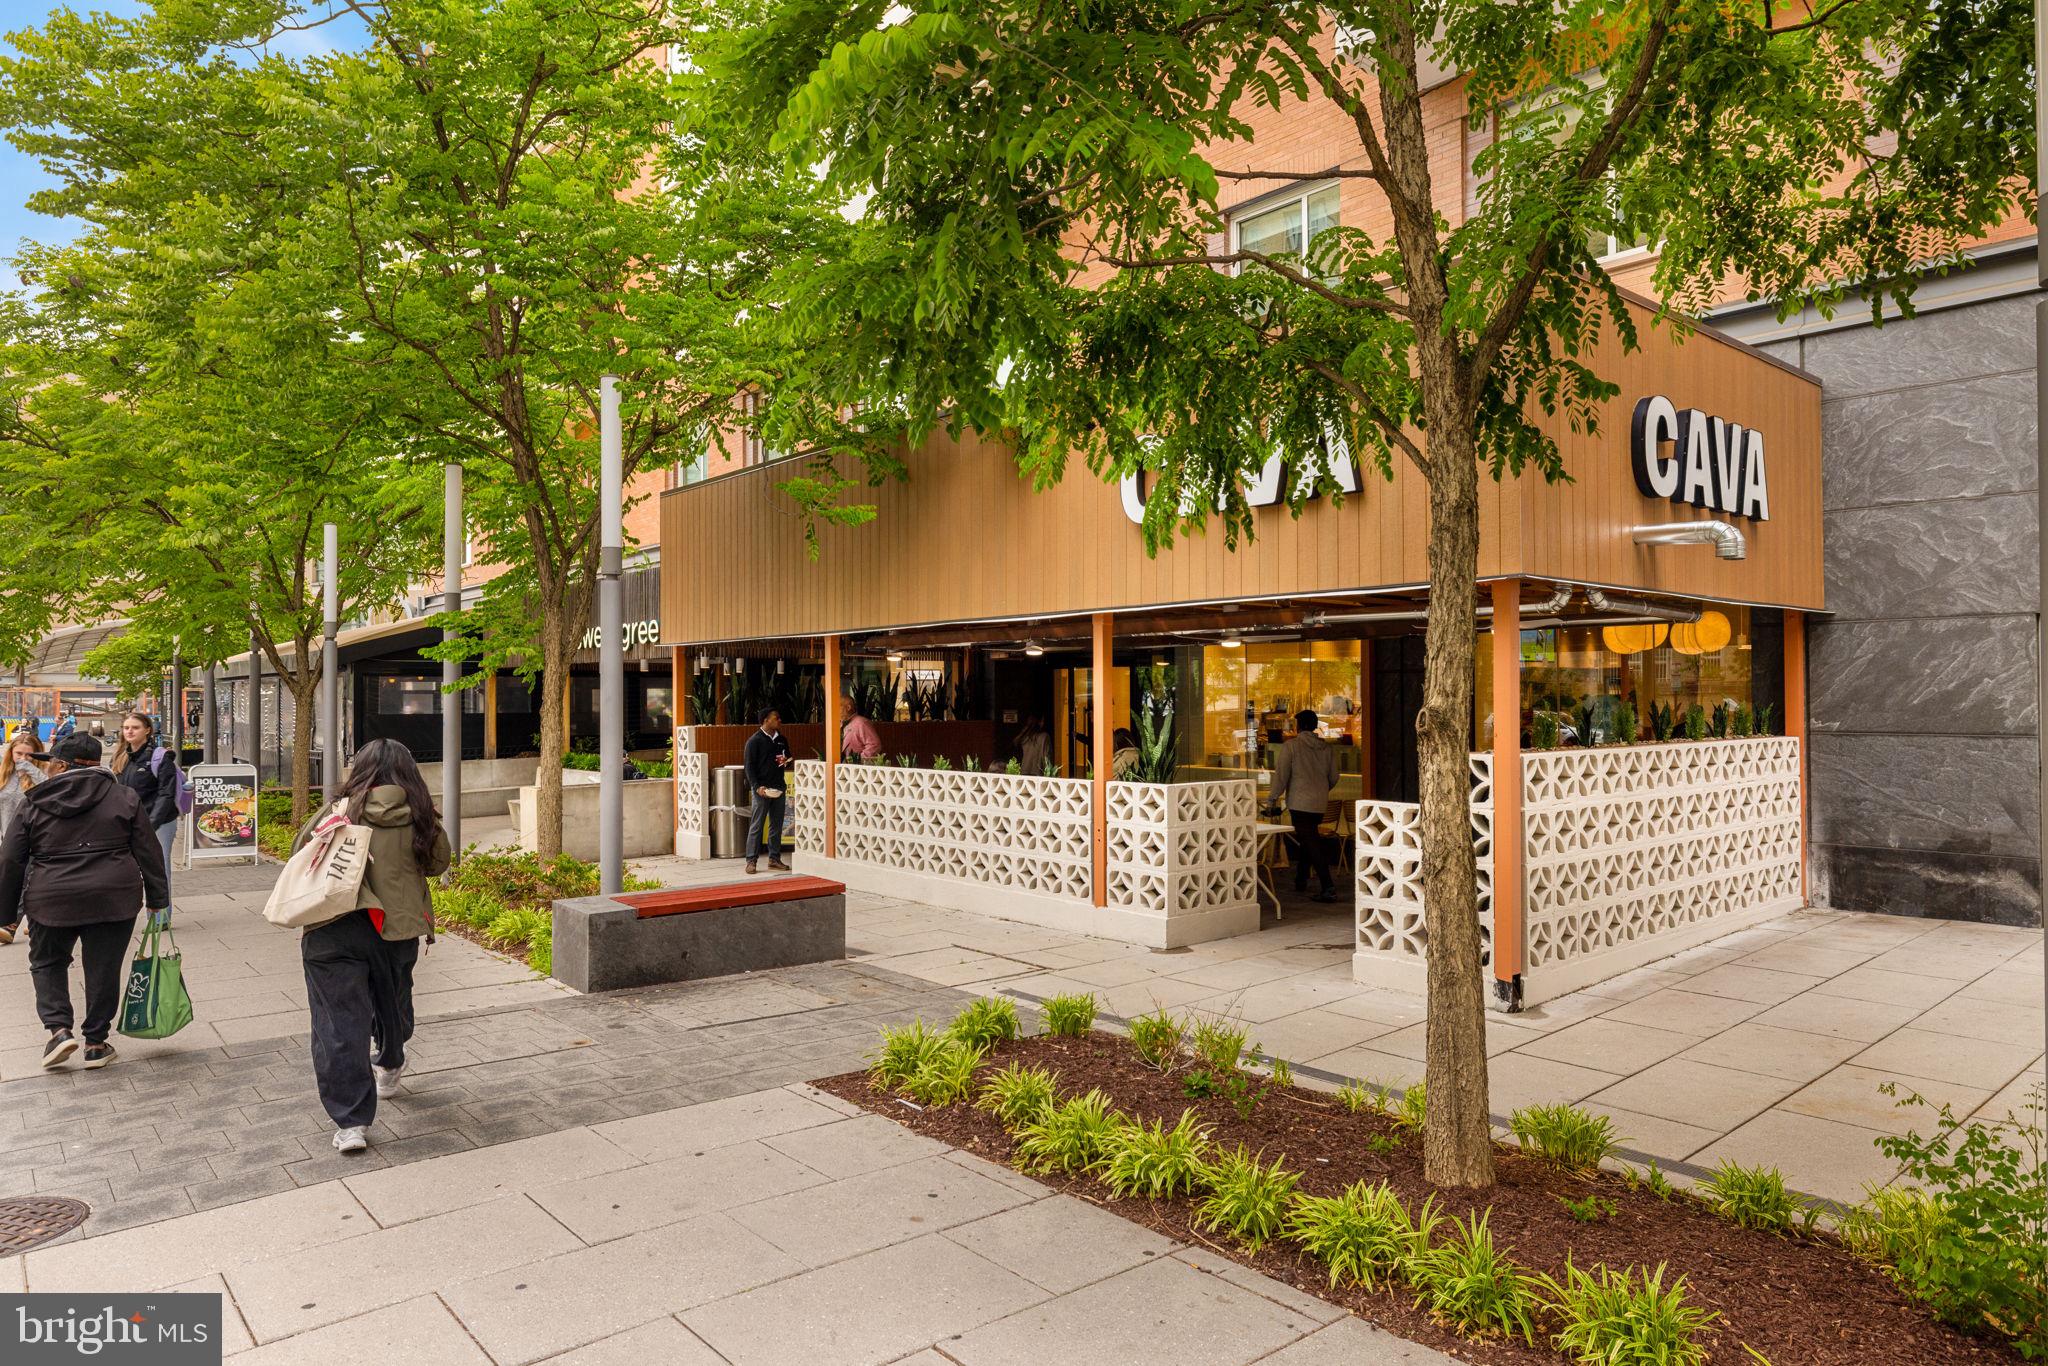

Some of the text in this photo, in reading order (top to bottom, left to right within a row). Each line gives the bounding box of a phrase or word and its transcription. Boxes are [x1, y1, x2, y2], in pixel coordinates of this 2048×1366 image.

[1120, 397, 1363, 524] CVA
[1632, 395, 1769, 521] CAVA
[194, 784, 244, 792] FLAVORS,
[195, 797, 235, 805] LAYERS
[326, 836, 357, 880] TATTE
